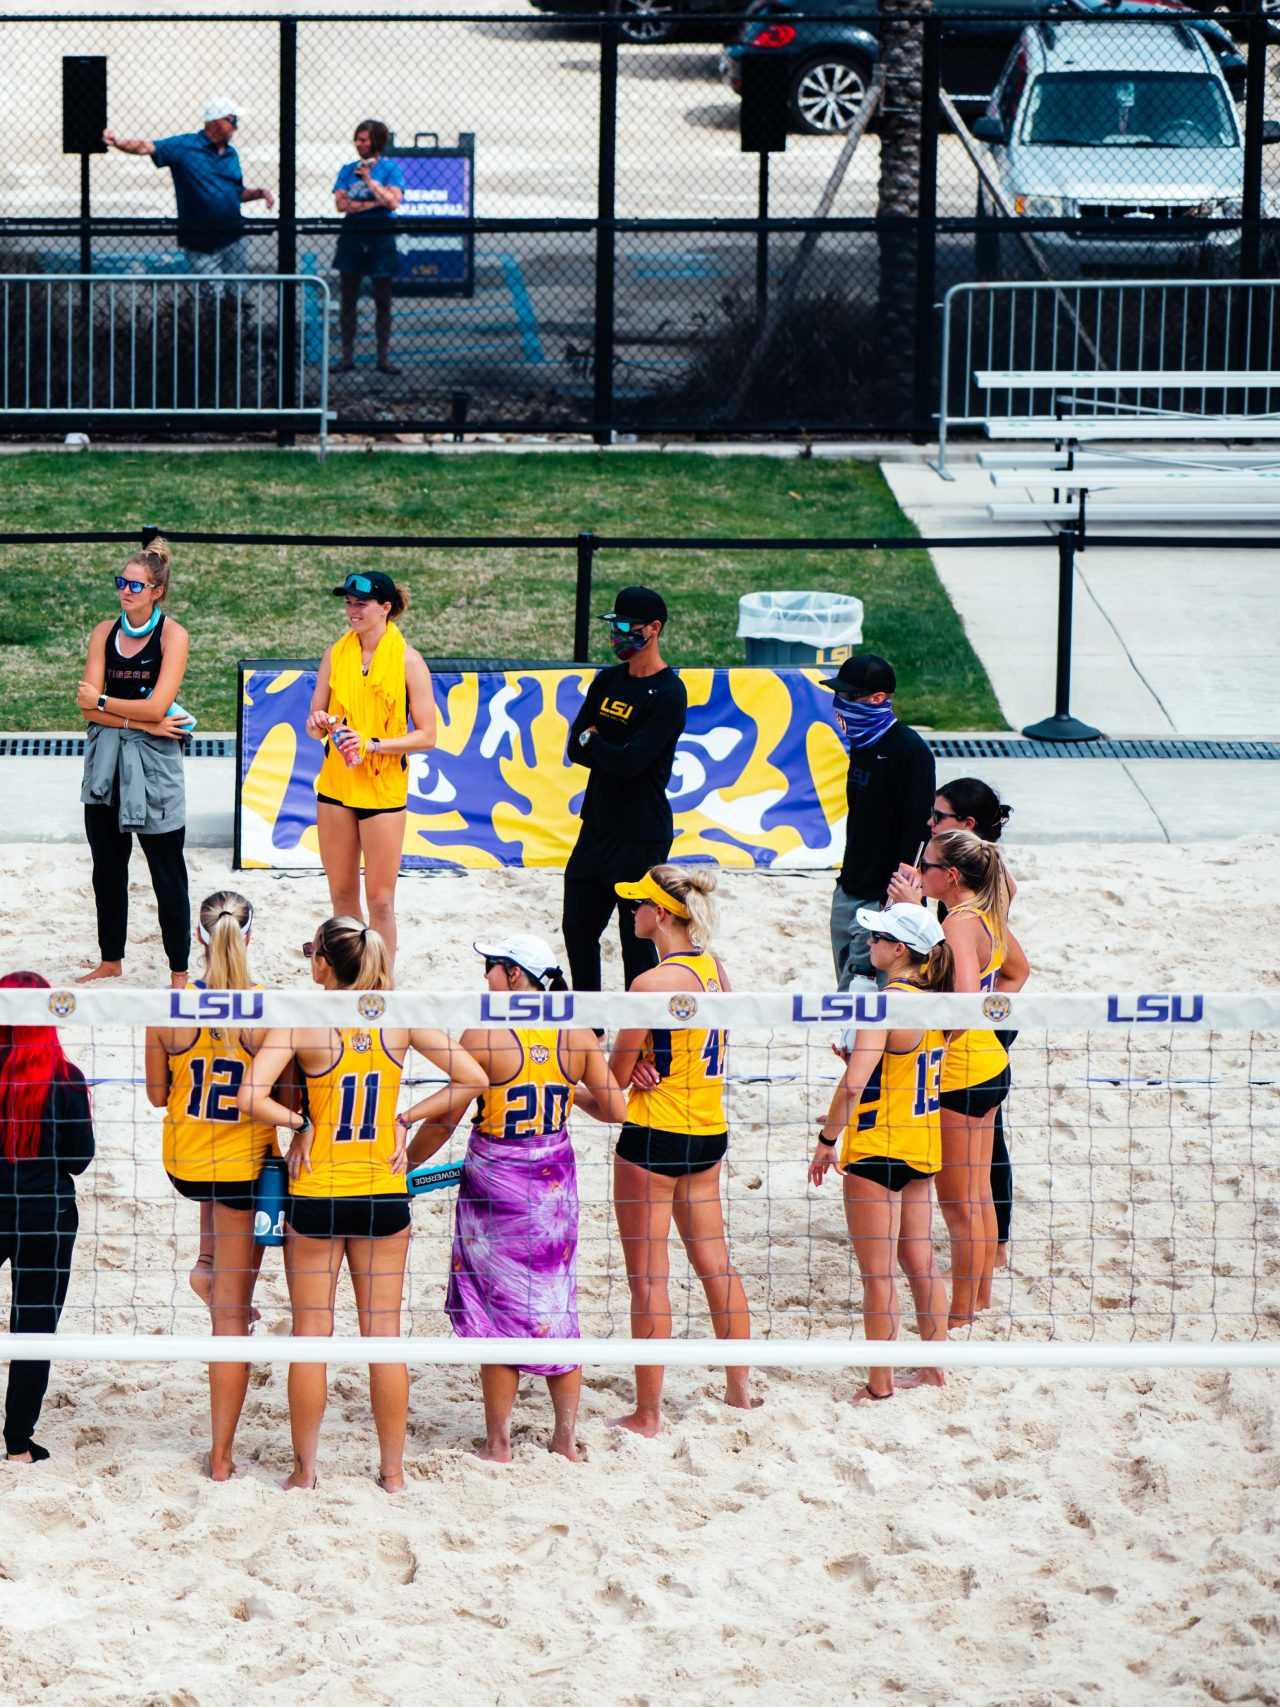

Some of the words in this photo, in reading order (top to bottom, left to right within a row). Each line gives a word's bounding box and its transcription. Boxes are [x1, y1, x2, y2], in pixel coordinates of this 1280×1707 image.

[107, 668, 151, 679] TIGERS
[170, 992, 263, 1019] LSU
[480, 993, 574, 1021] LSU
[792, 994, 887, 1022] LSU
[1107, 994, 1203, 1022] LSU
[186, 1057, 245, 1122] 12
[335, 1072, 379, 1141] 11
[504, 1083, 570, 1139] 20
